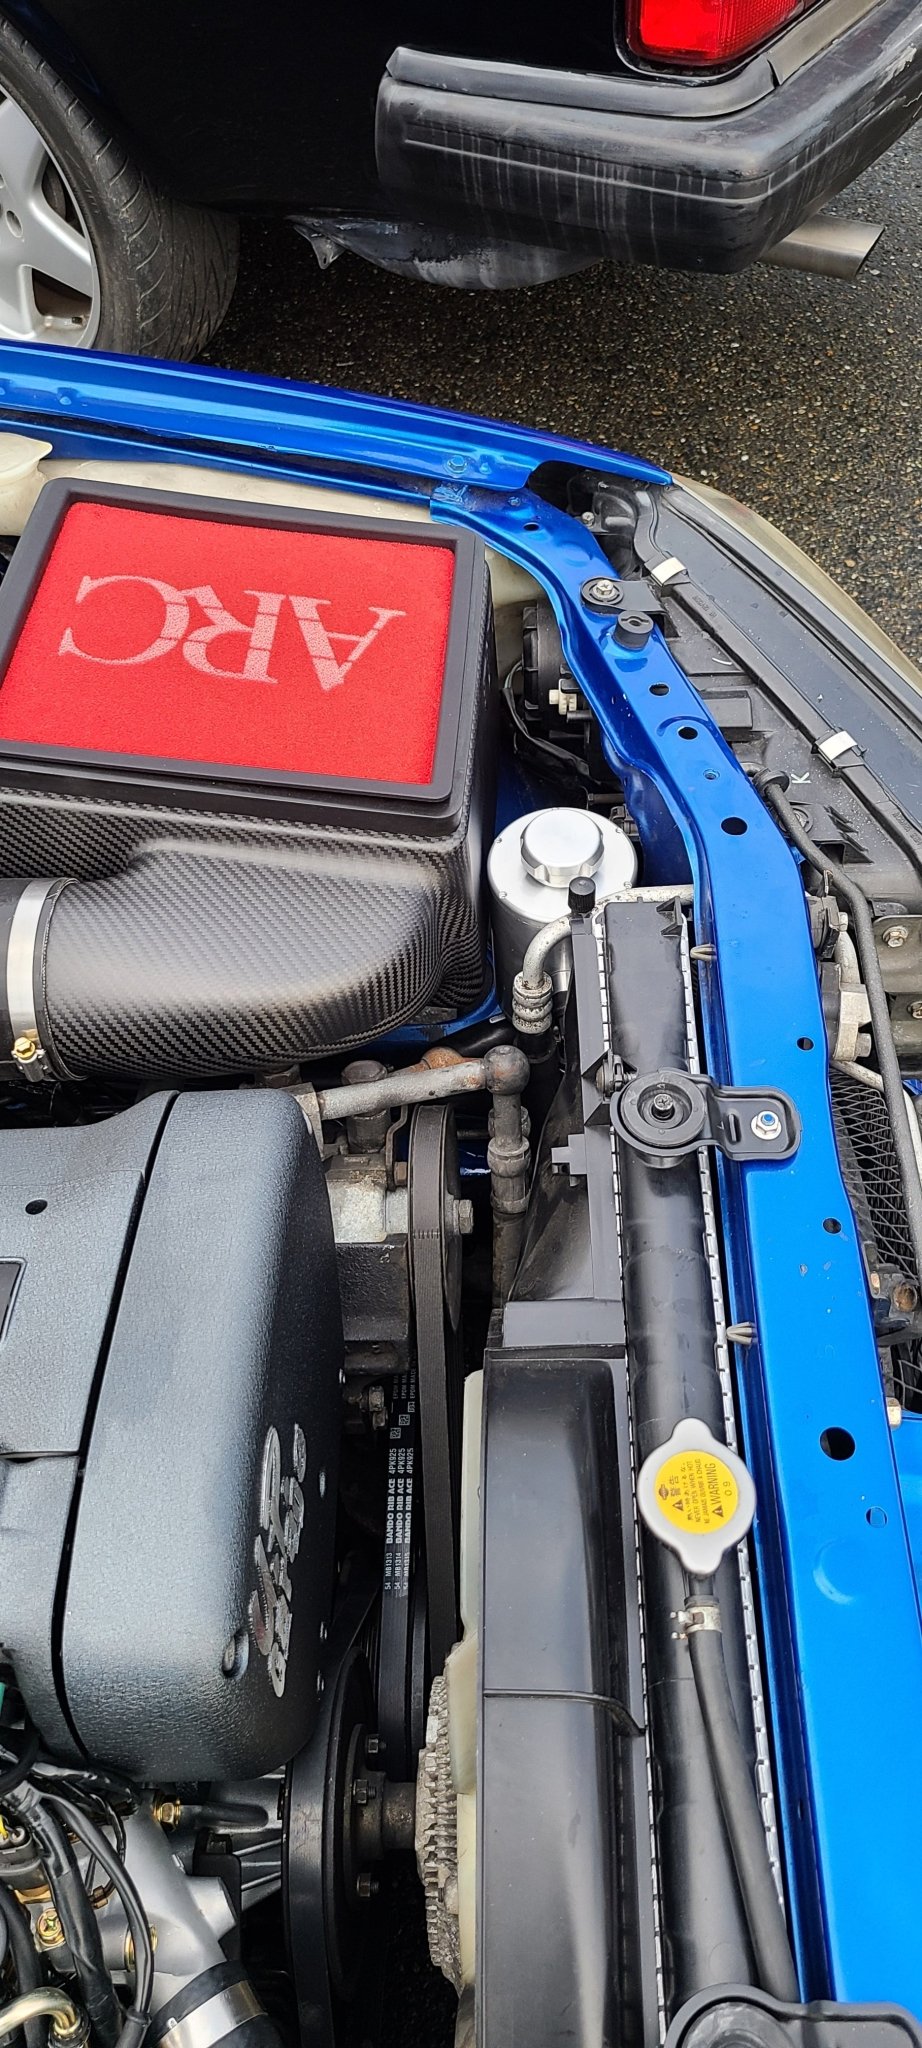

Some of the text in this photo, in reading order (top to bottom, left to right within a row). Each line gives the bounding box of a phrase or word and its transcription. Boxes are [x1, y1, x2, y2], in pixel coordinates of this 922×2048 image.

[58, 575, 406, 692] ARC
[389, 1448, 397, 1474] 4PK925
[398, 1448, 406, 1474] 4PK925
[406, 1448, 414, 1474] 4PK925
[388, 1478, 396, 1494] ACE
[397, 1478, 405, 1494] ACE
[688, 1473, 696, 1488] WHEN
[704, 1463, 721, 1505] WARNING
[387, 1496, 395, 1511] RIB
[396, 1496, 404, 1511] RIB
[405, 1496, 413, 1511] RIB
[691, 1490, 699, 1504] OPEN
[693, 1506, 701, 1522] NEVER
[386, 1512, 394, 1544] BANDO
[395, 1512, 403, 1544] BANDO
[404, 1512, 412, 1544] BANDO
[384, 1581, 391, 1590] 54
[394, 1581, 401, 1590] 54
